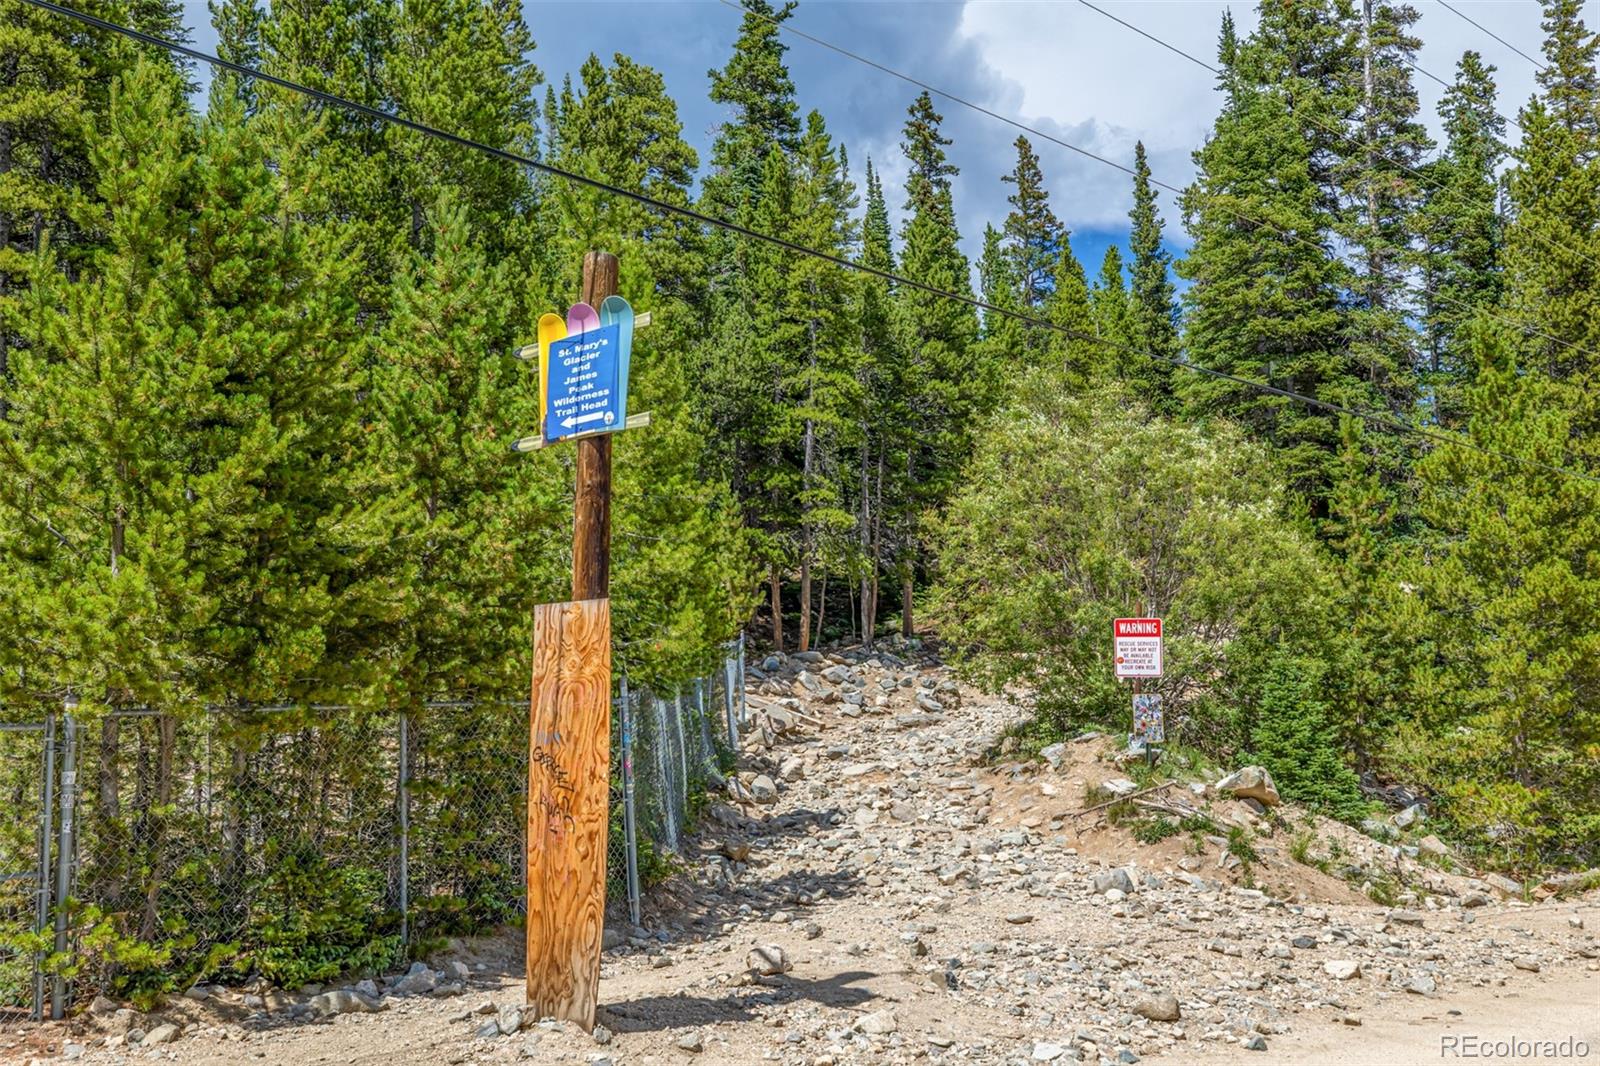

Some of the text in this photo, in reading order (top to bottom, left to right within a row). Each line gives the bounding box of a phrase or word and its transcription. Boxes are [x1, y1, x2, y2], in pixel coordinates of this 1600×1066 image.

[558, 338, 608, 357] St. Mary's
[563, 350, 600, 366] Glacier
[571, 362, 591, 374] and
[564, 371, 598, 385] James
[568, 382, 594, 394] Peak
[553, 388, 610, 408] Wilderness
[555, 398, 608, 417] Trail Head
[1119, 622, 1158, 634] WARNING
